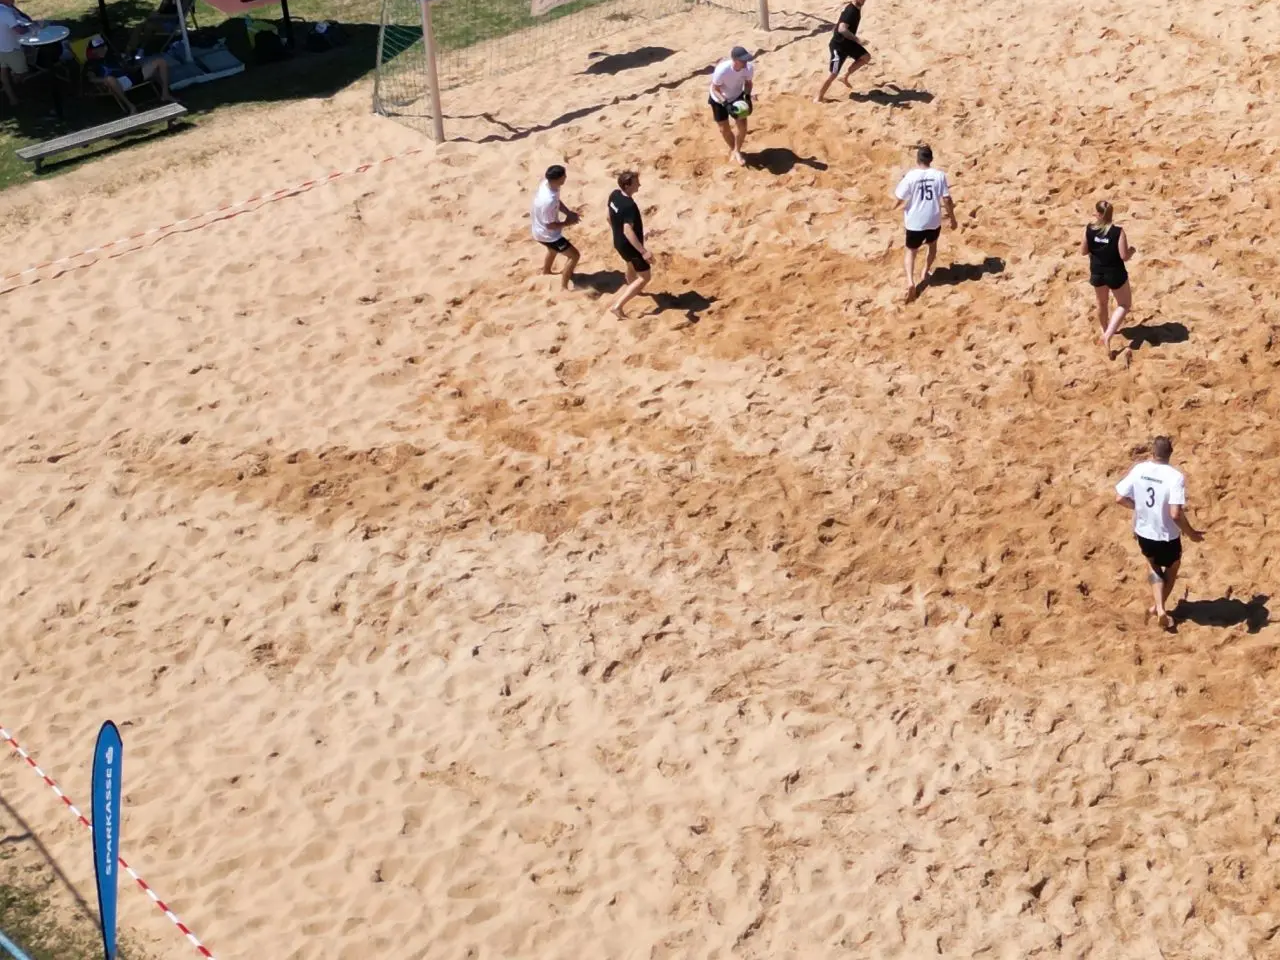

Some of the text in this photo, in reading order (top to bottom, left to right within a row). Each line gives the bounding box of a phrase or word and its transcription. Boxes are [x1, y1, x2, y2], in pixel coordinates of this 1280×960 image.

[918, 184, 933, 201] 15
[1145, 486, 1155, 508] 3
[105, 767, 113, 876] SPARKASSE
